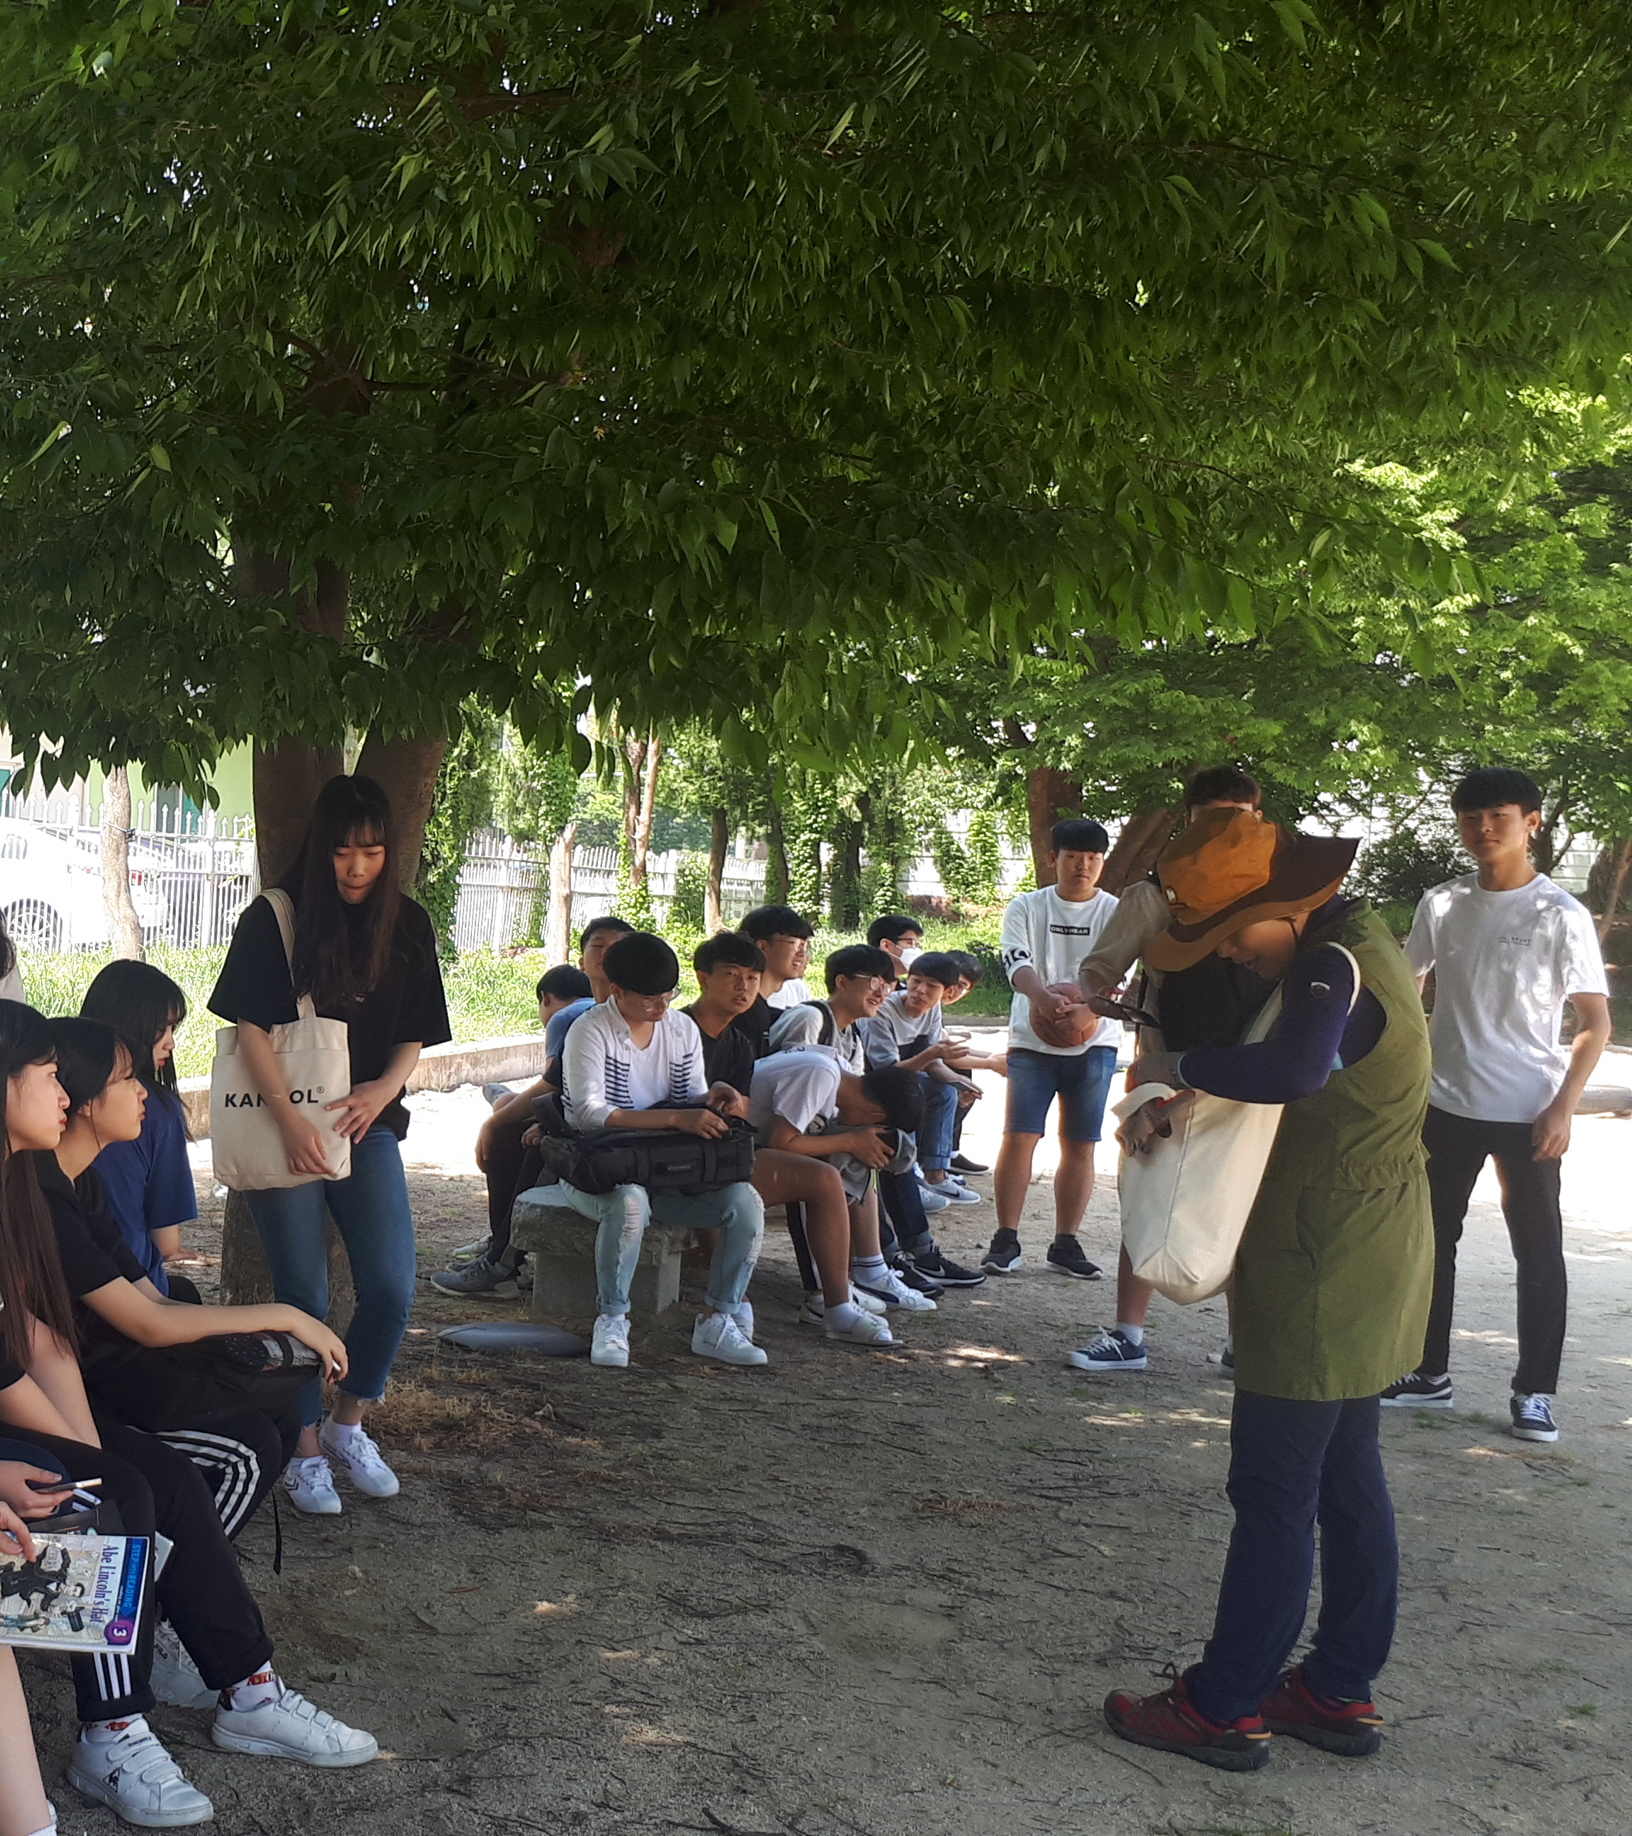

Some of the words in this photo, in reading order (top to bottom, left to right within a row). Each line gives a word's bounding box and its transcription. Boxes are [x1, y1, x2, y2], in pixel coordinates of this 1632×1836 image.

[224, 1089, 319, 1108] KANOL
[101, 1545, 120, 1564] Abe
[132, 1544, 141, 1563] STEP
[93, 1566, 117, 1606] Lincoln's
[123, 1574, 136, 1608] READING
[90, 1607, 110, 1624] Hat
[112, 1627, 127, 1638] 3
[154, 1643, 168, 1659] FILA
